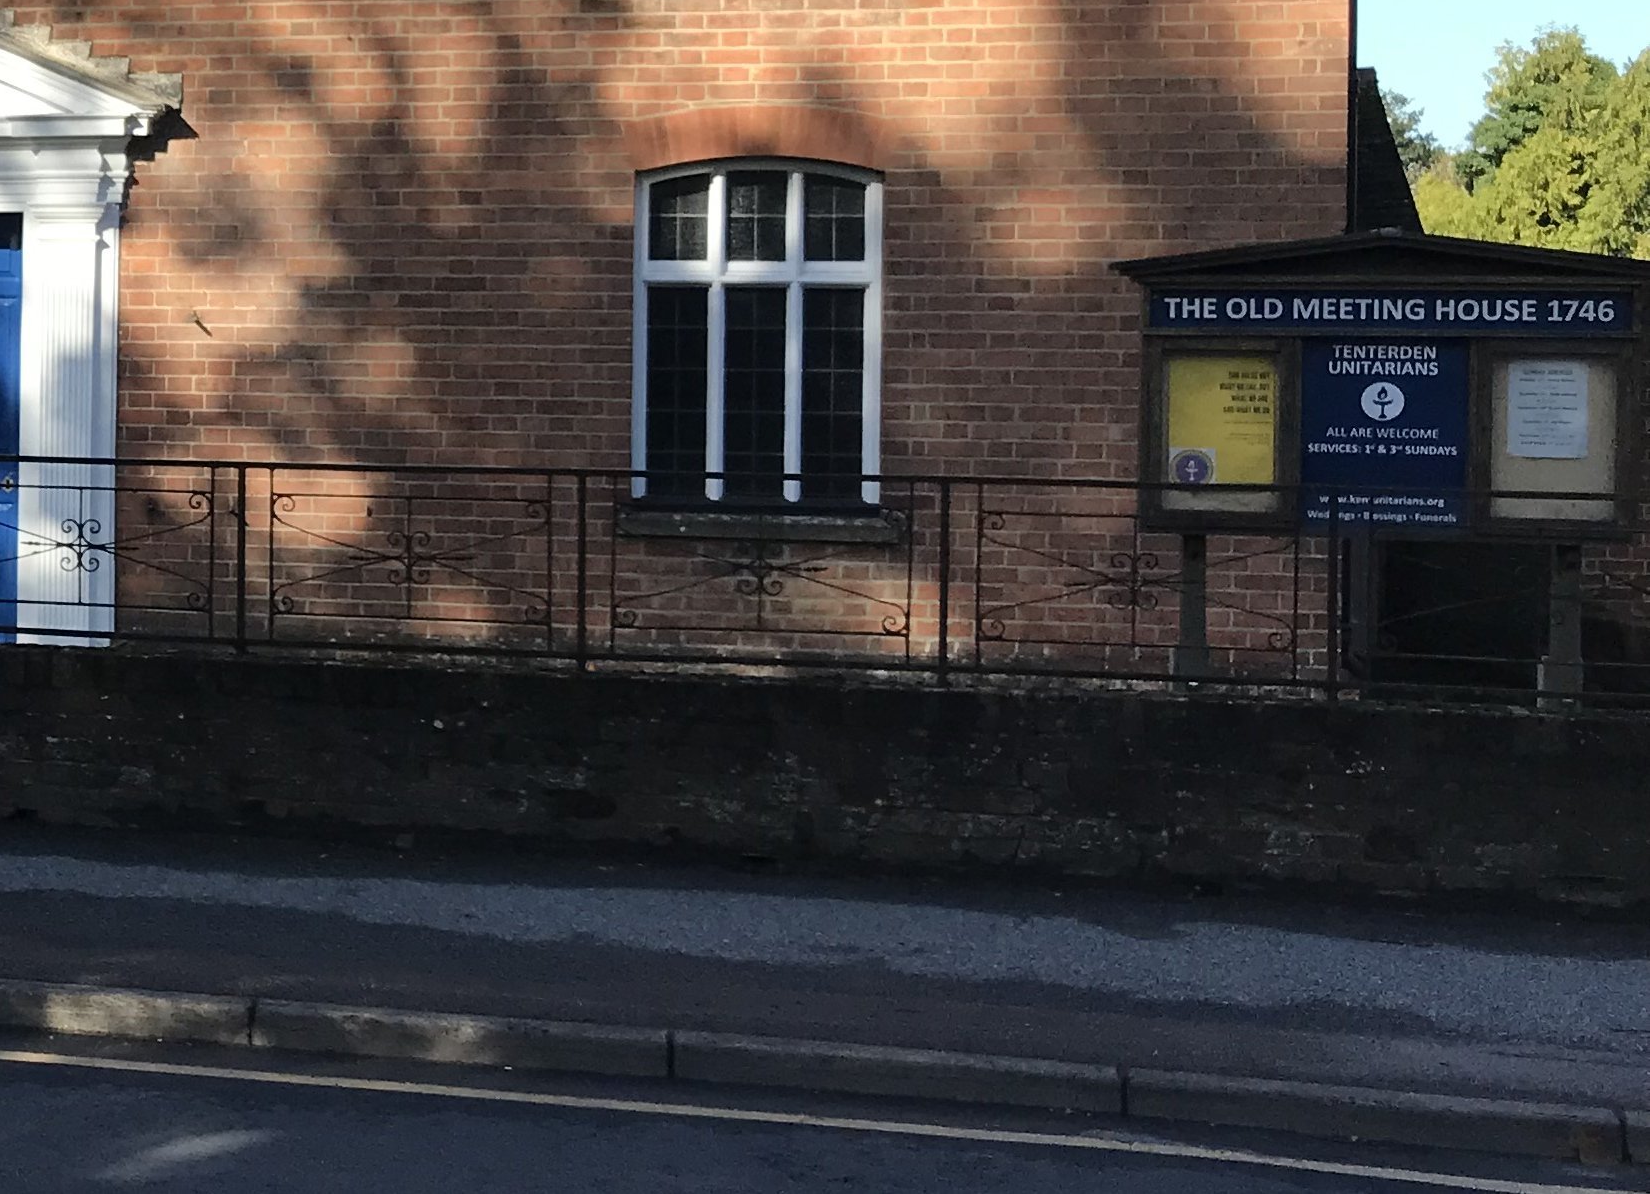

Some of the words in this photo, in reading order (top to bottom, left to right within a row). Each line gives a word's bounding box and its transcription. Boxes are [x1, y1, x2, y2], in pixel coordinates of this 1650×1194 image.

[1163, 297, 1218, 319] THE
[1225, 297, 1284, 319] OLD
[1292, 297, 1426, 321] MEETING
[1435, 299, 1538, 322] HOUSE
[1546, 299, 1615, 322] 1746
[1332, 344, 1437, 360] TENTERDEN
[1328, 360, 1439, 376] UNITARIANS
[1325, 427, 1347, 438] ALL
[1349, 427, 1373, 439] ARE
[1376, 428, 1439, 440] WELCOME
[1307, 442, 1363, 454] SERVICES:
[1377, 444, 1387, 454] &
[1404, 444, 1458, 456] SUNDAYS
[1318, 494, 1445, 508] ww.kenunitarians.org
[1306, 509, 1356, 521] Wedngs
[1362, 511, 1408, 523] Bessings
[1414, 512, 1458, 523] Funerals
